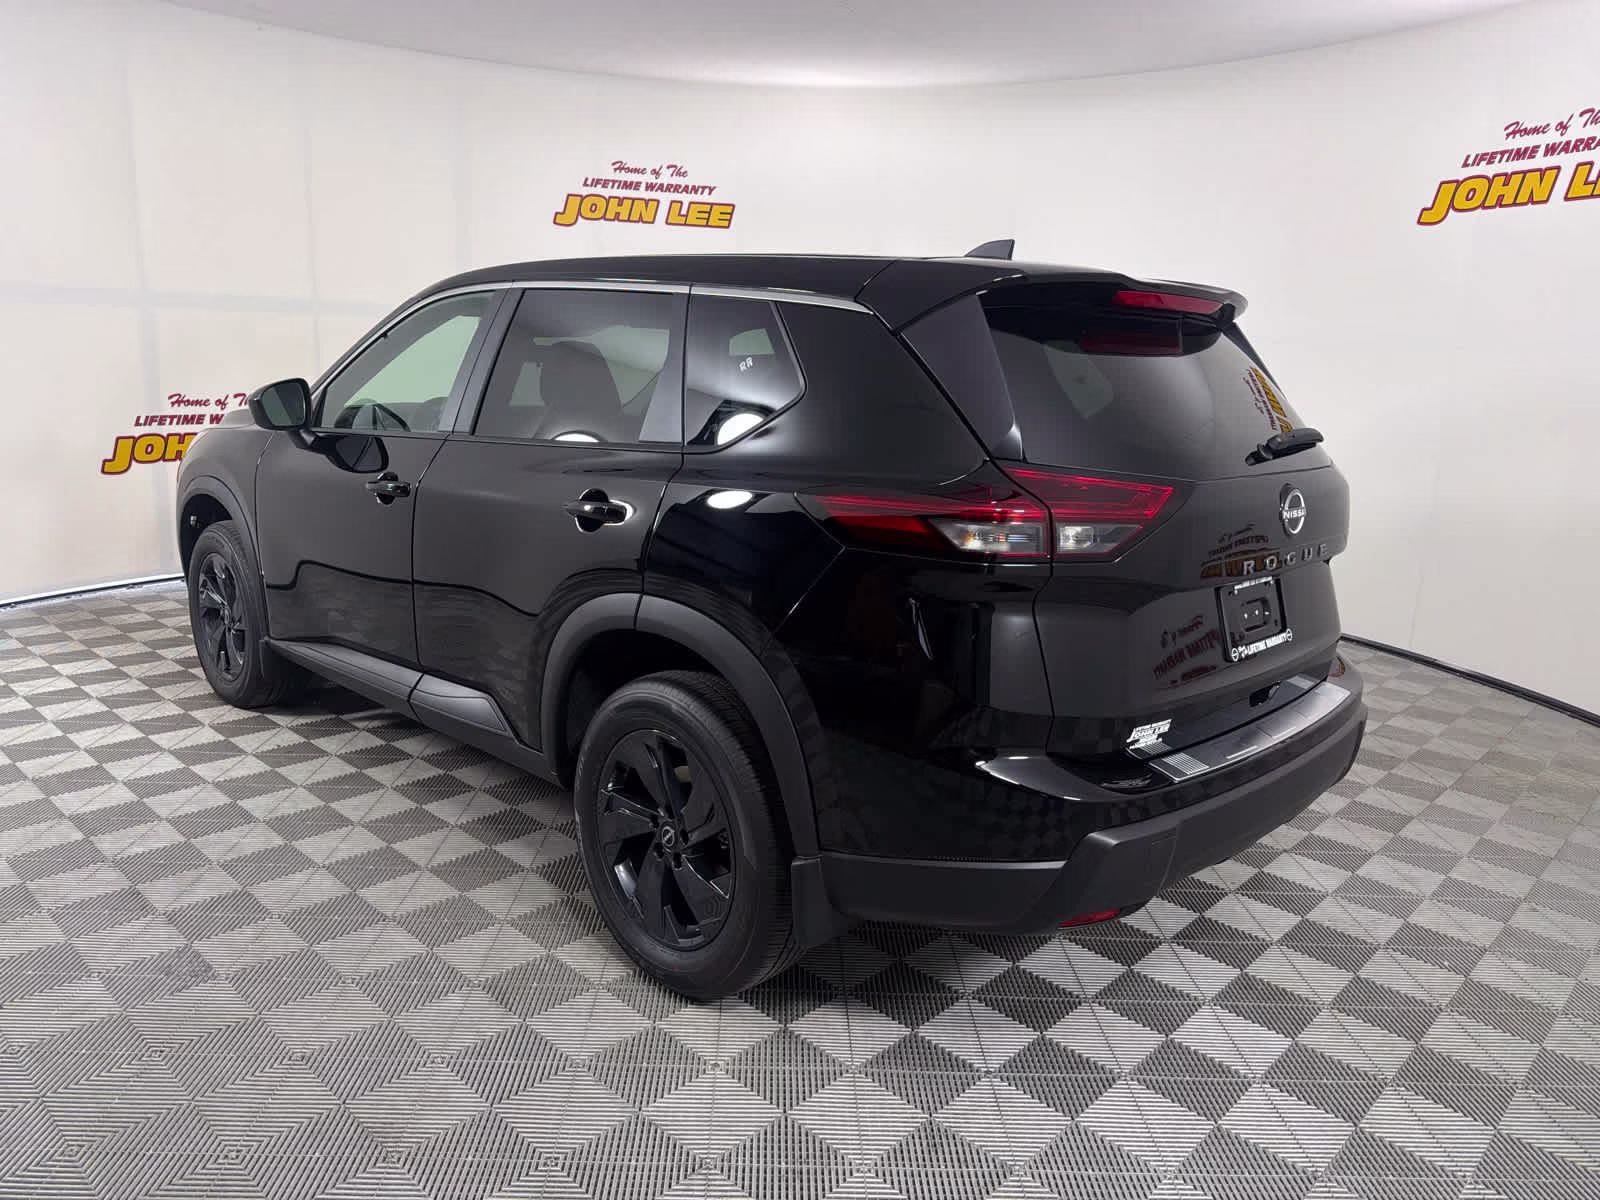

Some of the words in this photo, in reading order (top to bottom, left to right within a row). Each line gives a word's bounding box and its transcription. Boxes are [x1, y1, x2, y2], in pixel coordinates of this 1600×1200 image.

[1504, 121, 1551, 141] Home
[1554, 113, 1574, 136] of
[1579, 107, 1600, 128] Th
[611, 160, 648, 176] Home
[650, 165, 663, 179] of
[666, 165, 689, 178] The
[1461, 144, 1541, 169] LIFETIME
[583, 177, 643, 192] LIFETIME
[645, 182, 716, 196] WARRANTY
[1417, 165, 1562, 226] JOHN
[553, 194, 660, 227] JOHN
[665, 200, 736, 229] LEE
[168, 393, 211, 408] Home
[215, 394, 229, 410] of
[134, 413, 207, 427] LIFETIME
[101, 432, 199, 475] JOH
[1243, 543, 1329, 576] ROGUE
